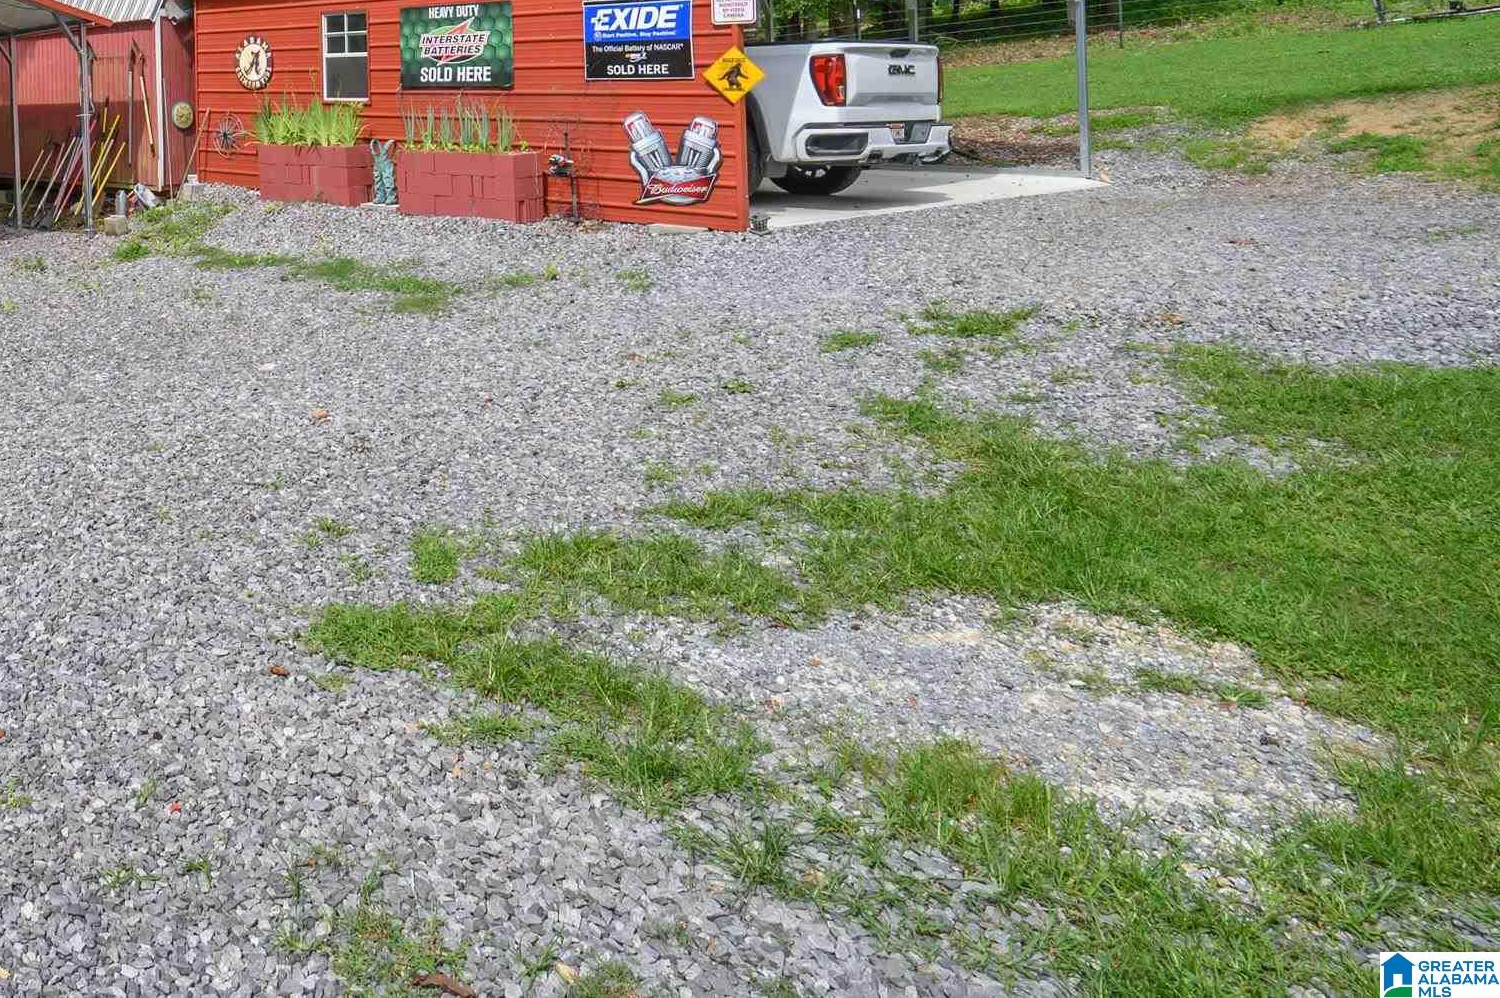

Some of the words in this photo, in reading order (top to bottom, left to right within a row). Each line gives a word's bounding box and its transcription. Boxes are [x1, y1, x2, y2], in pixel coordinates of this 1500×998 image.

[428, 6, 454, 19] HEAVY
[456, 4, 480, 17] DUTY
[590, 5, 680, 31] EXIDE
[421, 33, 485, 45] INTERSTATE
[423, 44, 481, 56] BATTERIES
[625, 45, 646, 53] Battery
[420, 66, 453, 82] SOLD
[457, 65, 492, 82] HERE
[607, 64, 635, 75] SOLD
[638, 63, 669, 75] HERE
[888, 64, 916, 75] GMC
[650, 183, 708, 195] Budweiser
